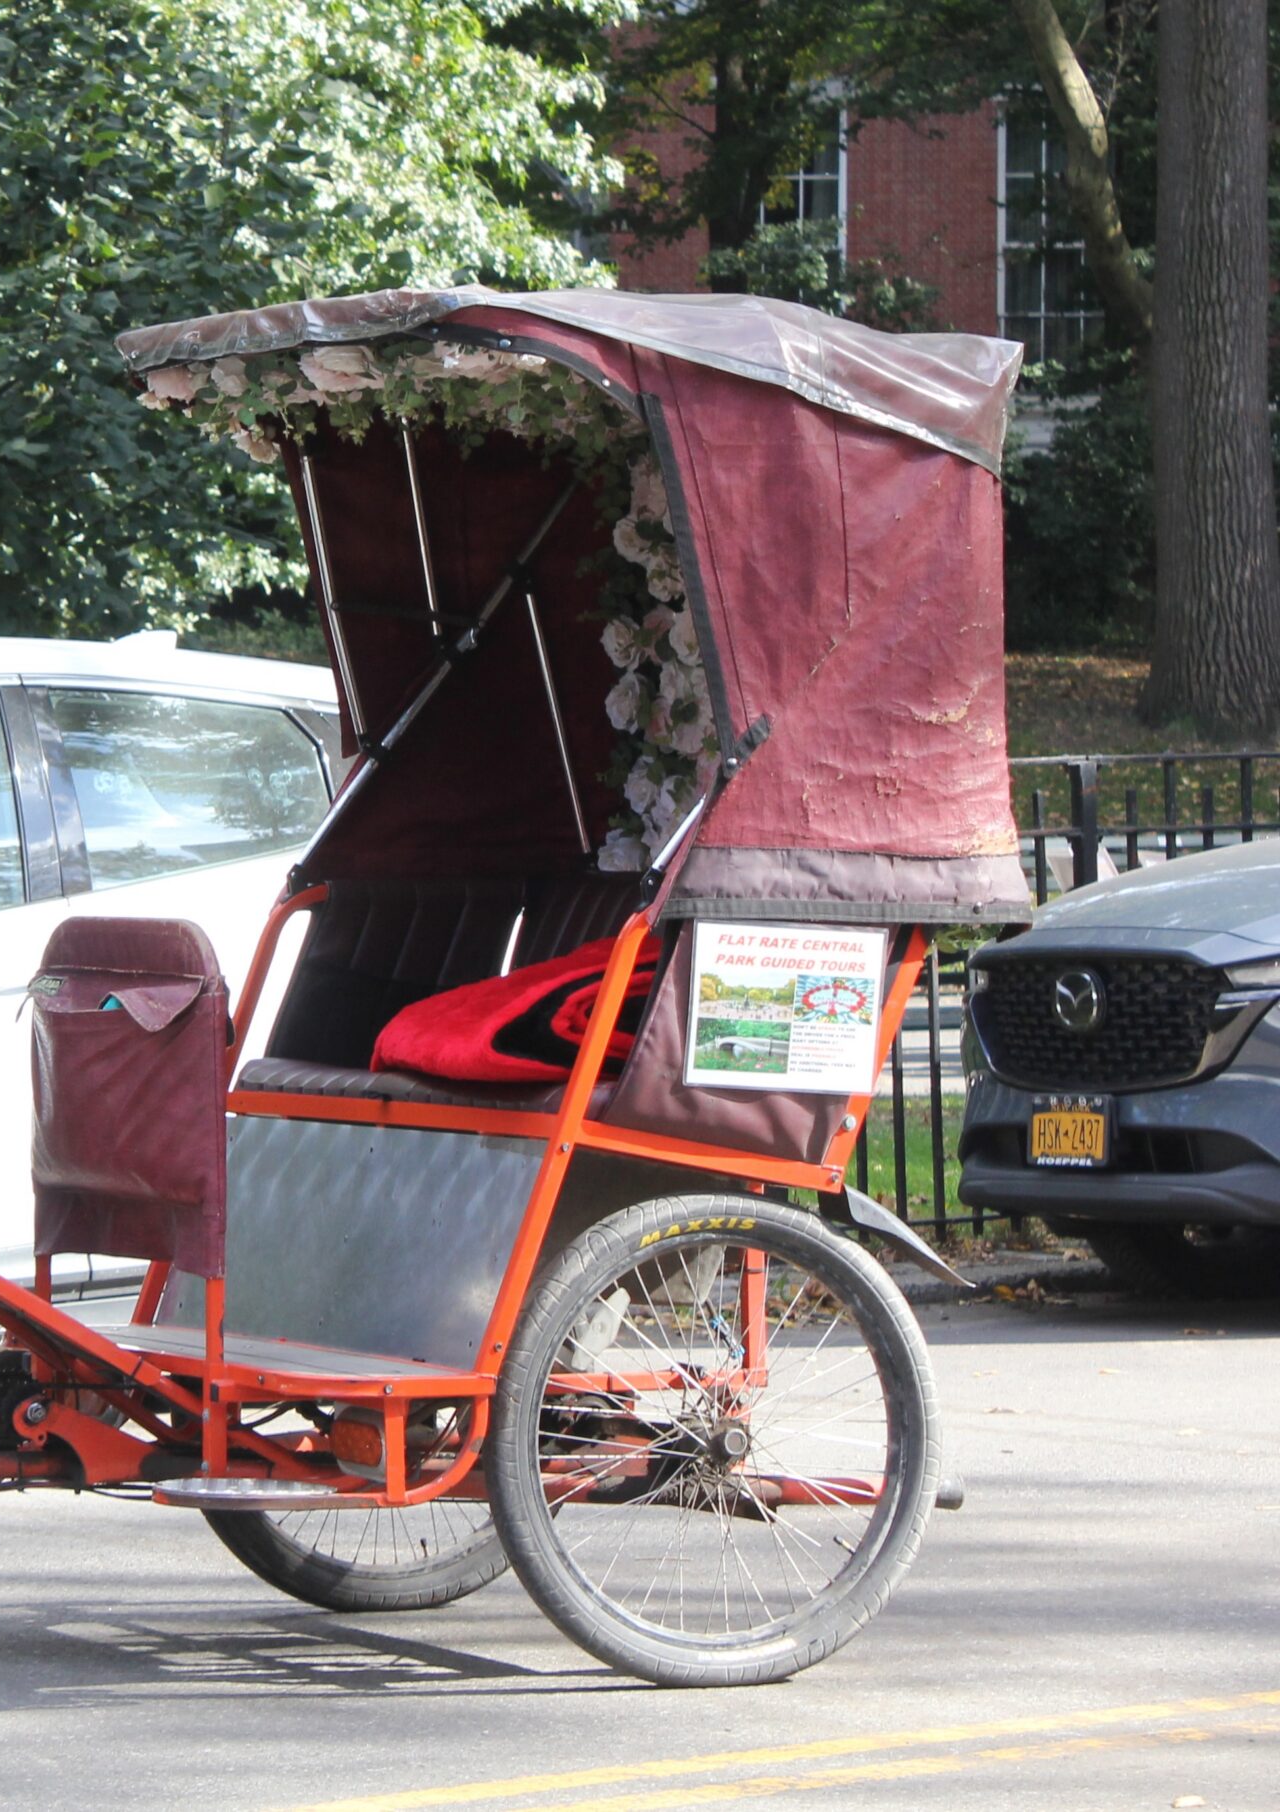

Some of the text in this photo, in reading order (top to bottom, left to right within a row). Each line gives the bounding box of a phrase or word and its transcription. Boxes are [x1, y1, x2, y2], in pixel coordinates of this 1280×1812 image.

[718, 934, 865, 953] FLAT RATE CENTRAL
[715, 953, 866, 973] PARK GUIDED TOURS
[1071, 1119, 1100, 1151] 2437
[1037, 1156, 1093, 1167] KOEPPEL
[640, 1217, 756, 1248] MAXXIS
